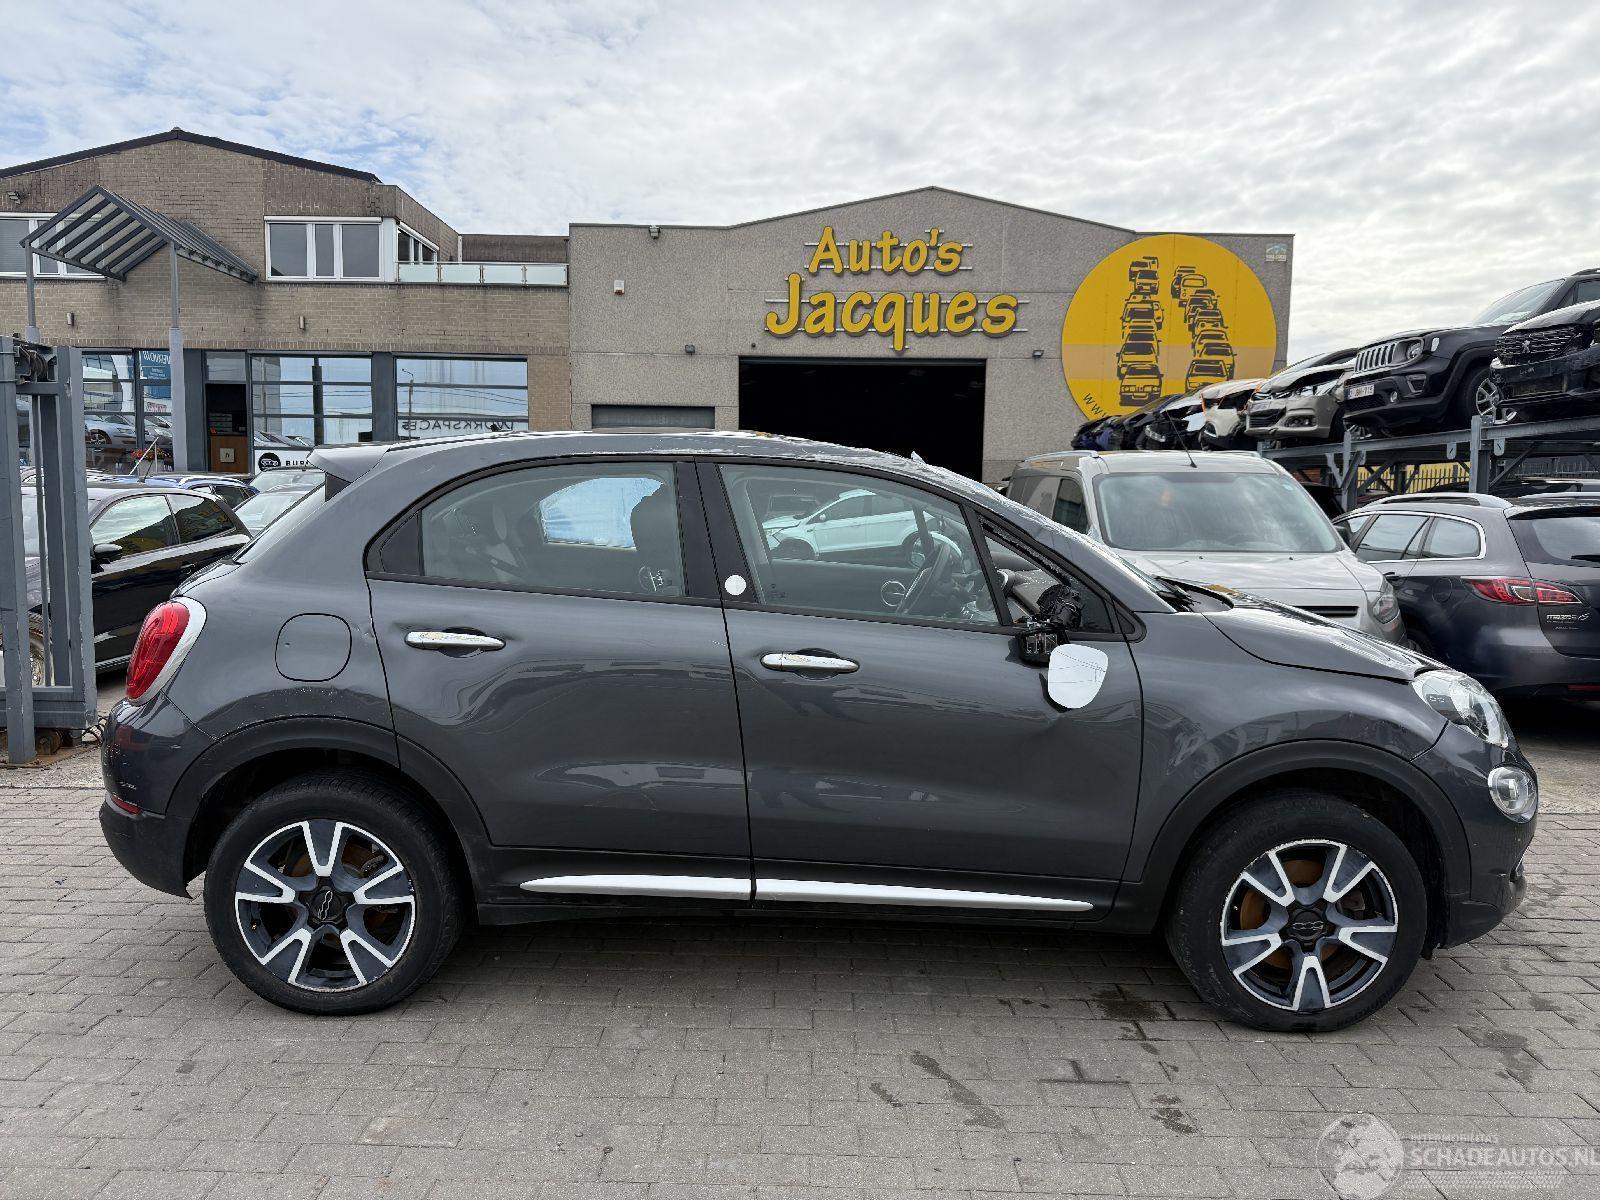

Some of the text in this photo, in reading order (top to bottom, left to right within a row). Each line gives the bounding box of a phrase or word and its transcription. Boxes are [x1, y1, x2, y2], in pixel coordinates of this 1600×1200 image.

[808, 226, 963, 274] Auto's
[766, 273, 1018, 351] Jacques
[1083, 393, 1106, 417] ww
